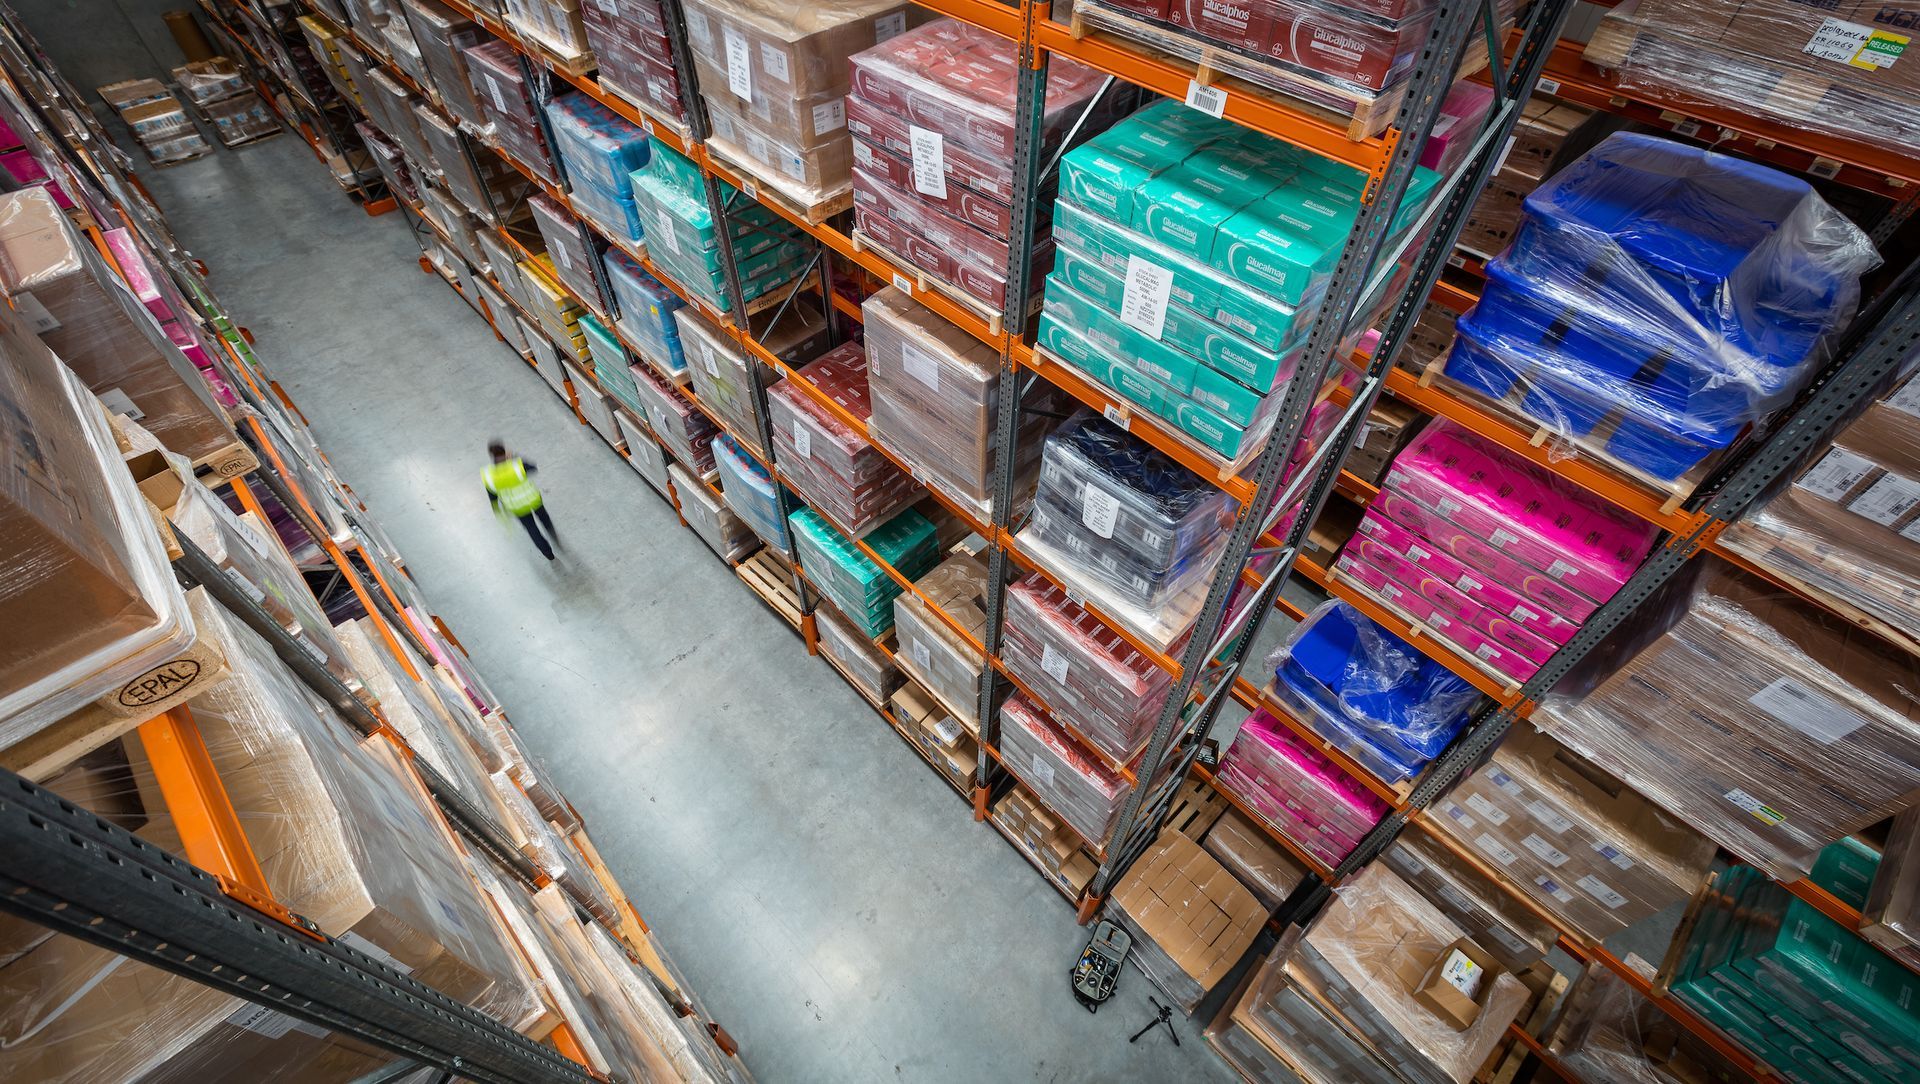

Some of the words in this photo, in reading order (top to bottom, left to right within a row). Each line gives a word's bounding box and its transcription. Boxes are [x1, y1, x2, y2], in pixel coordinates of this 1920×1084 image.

[1314, 27, 1366, 53] Glucalphos
[1869, 40, 1904, 54] RELEASED
[1087, 183, 1117, 203] Glucalmag
[972, 204, 1000, 221] Glucalphos
[1163, 217, 1197, 241] Glucalmag
[916, 246, 938, 262] Glucalphos
[1078, 268, 1107, 288] Glucalmag
[1247, 256, 1287, 280] Glucalmag
[968, 274, 992, 291] Glucalphos
[1135, 271, 1159, 287] GLUCALMAG
[1136, 278, 1157, 292] METABOLIC
[1222, 346, 1257, 371] Glucalmag
[1122, 374, 1151, 396] Glucalmag
[1191, 415, 1223, 439] Glucalmag
[223, 459, 245, 474] EPAL
[128, 667, 193, 702] EPAL
